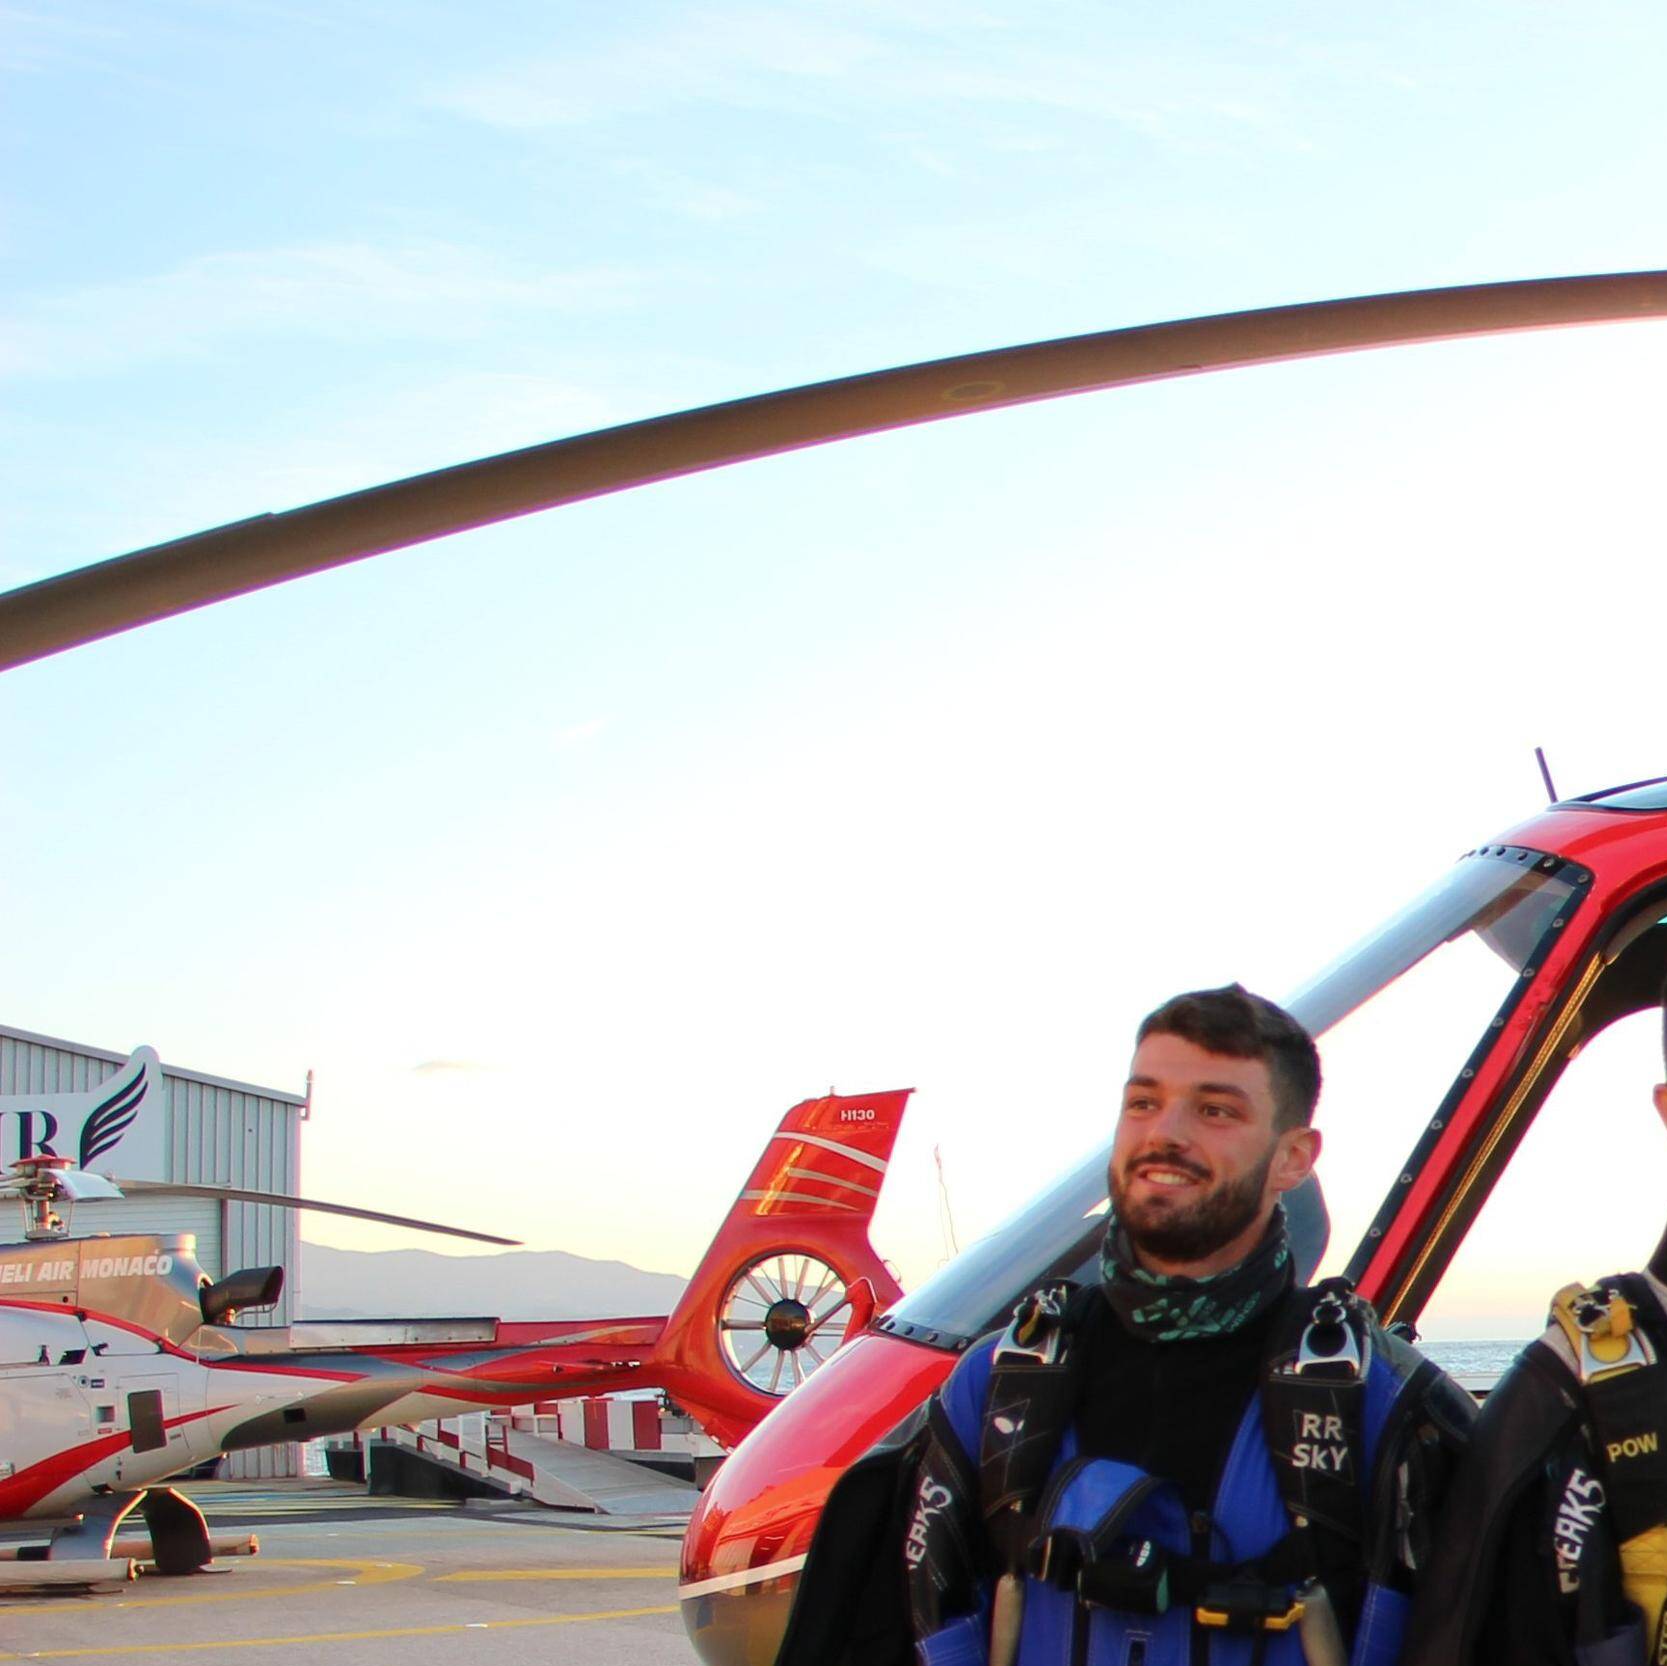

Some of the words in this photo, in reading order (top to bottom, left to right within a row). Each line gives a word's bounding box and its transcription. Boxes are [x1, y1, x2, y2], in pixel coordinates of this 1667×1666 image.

[841, 1109, 875, 1121] H130
[0, 1262, 32, 1284] ELI
[37, 1260, 74, 1281] AIR
[80, 1255, 174, 1279] MONACO
[1301, 1412, 1343, 1441] RR
[1606, 1431, 1659, 1464] POW
